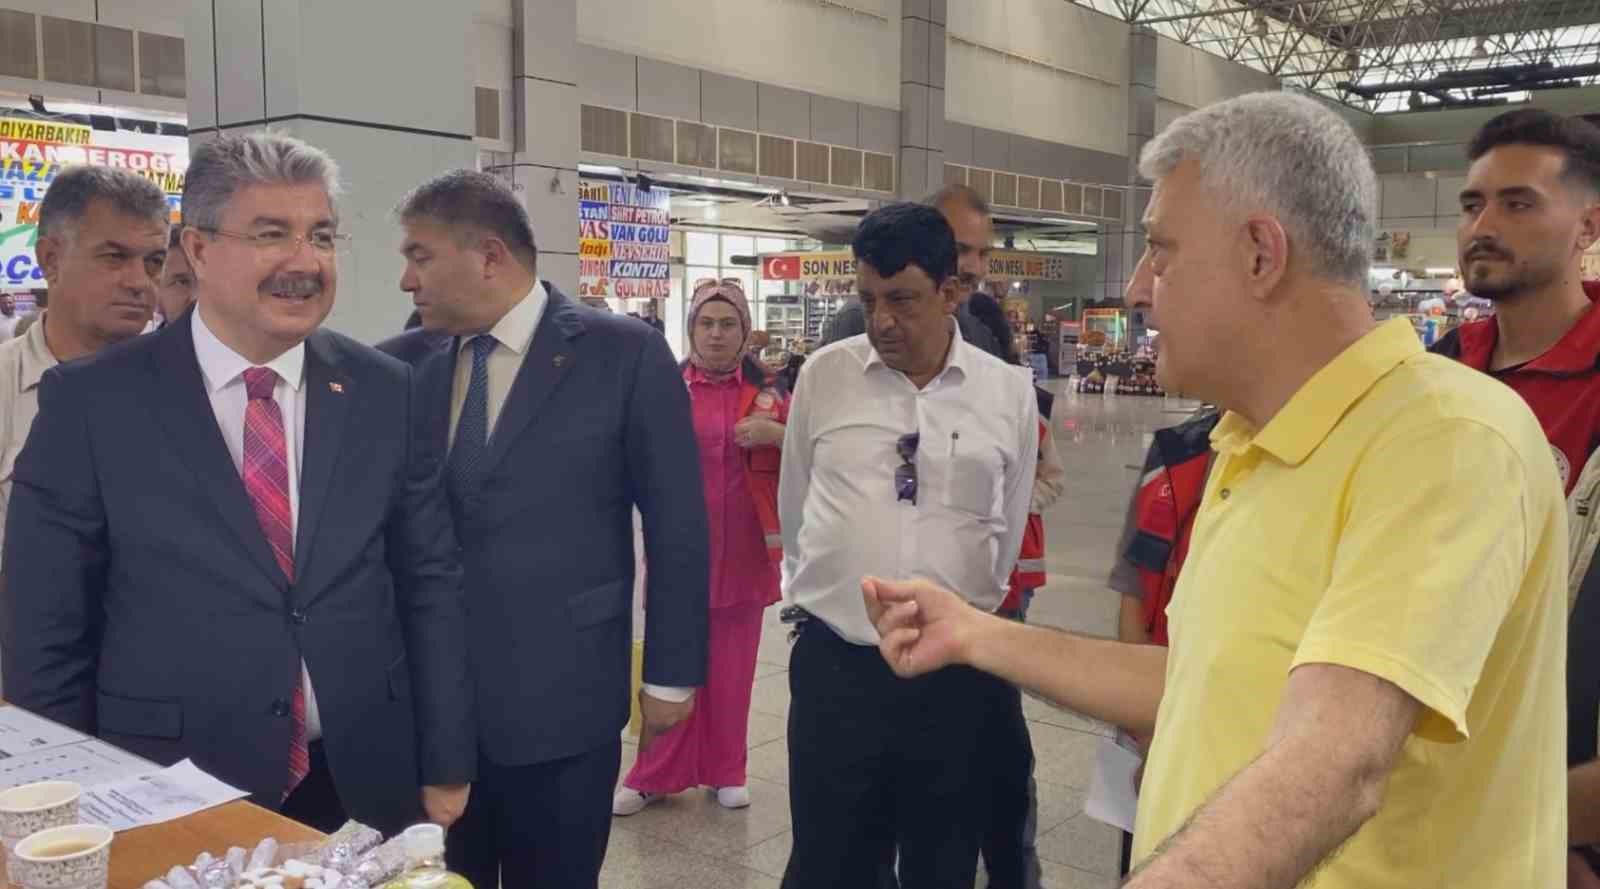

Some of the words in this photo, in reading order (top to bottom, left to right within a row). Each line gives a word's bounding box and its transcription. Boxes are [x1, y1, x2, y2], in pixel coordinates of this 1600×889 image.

[611, 223, 634, 241] VAN
[612, 262, 667, 277] KONTUR
[803, 260, 829, 275] SON
[990, 259, 1004, 274] SON
